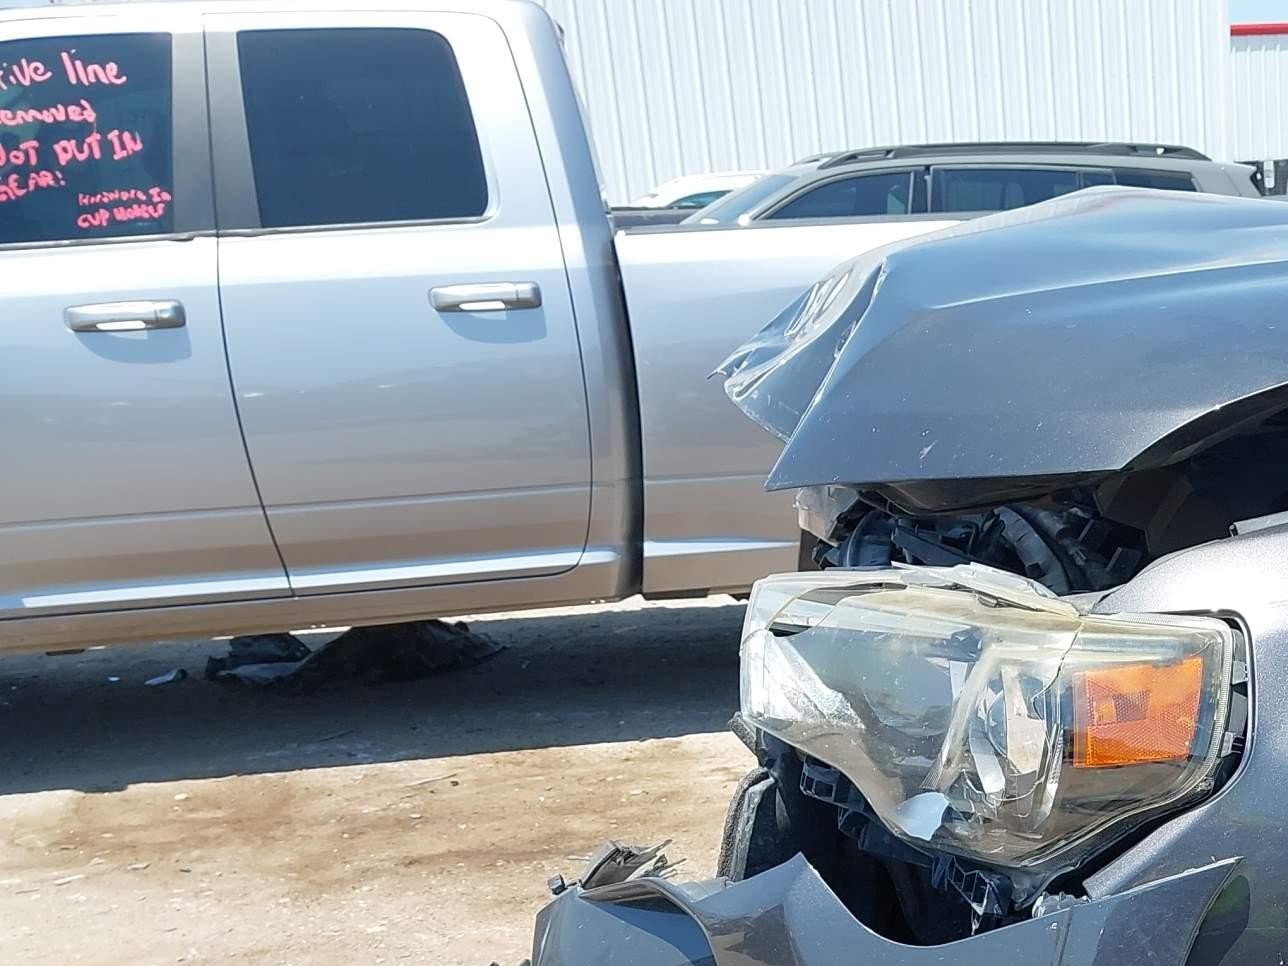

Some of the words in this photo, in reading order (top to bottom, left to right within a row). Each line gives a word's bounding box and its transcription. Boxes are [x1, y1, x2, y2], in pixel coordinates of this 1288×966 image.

[61, 49, 127, 86] line
[0, 99, 96, 126] emoved
[53, 132, 101, 166] PUT
[107, 129, 143, 160] IN
[77, 208, 110, 228] CUP
